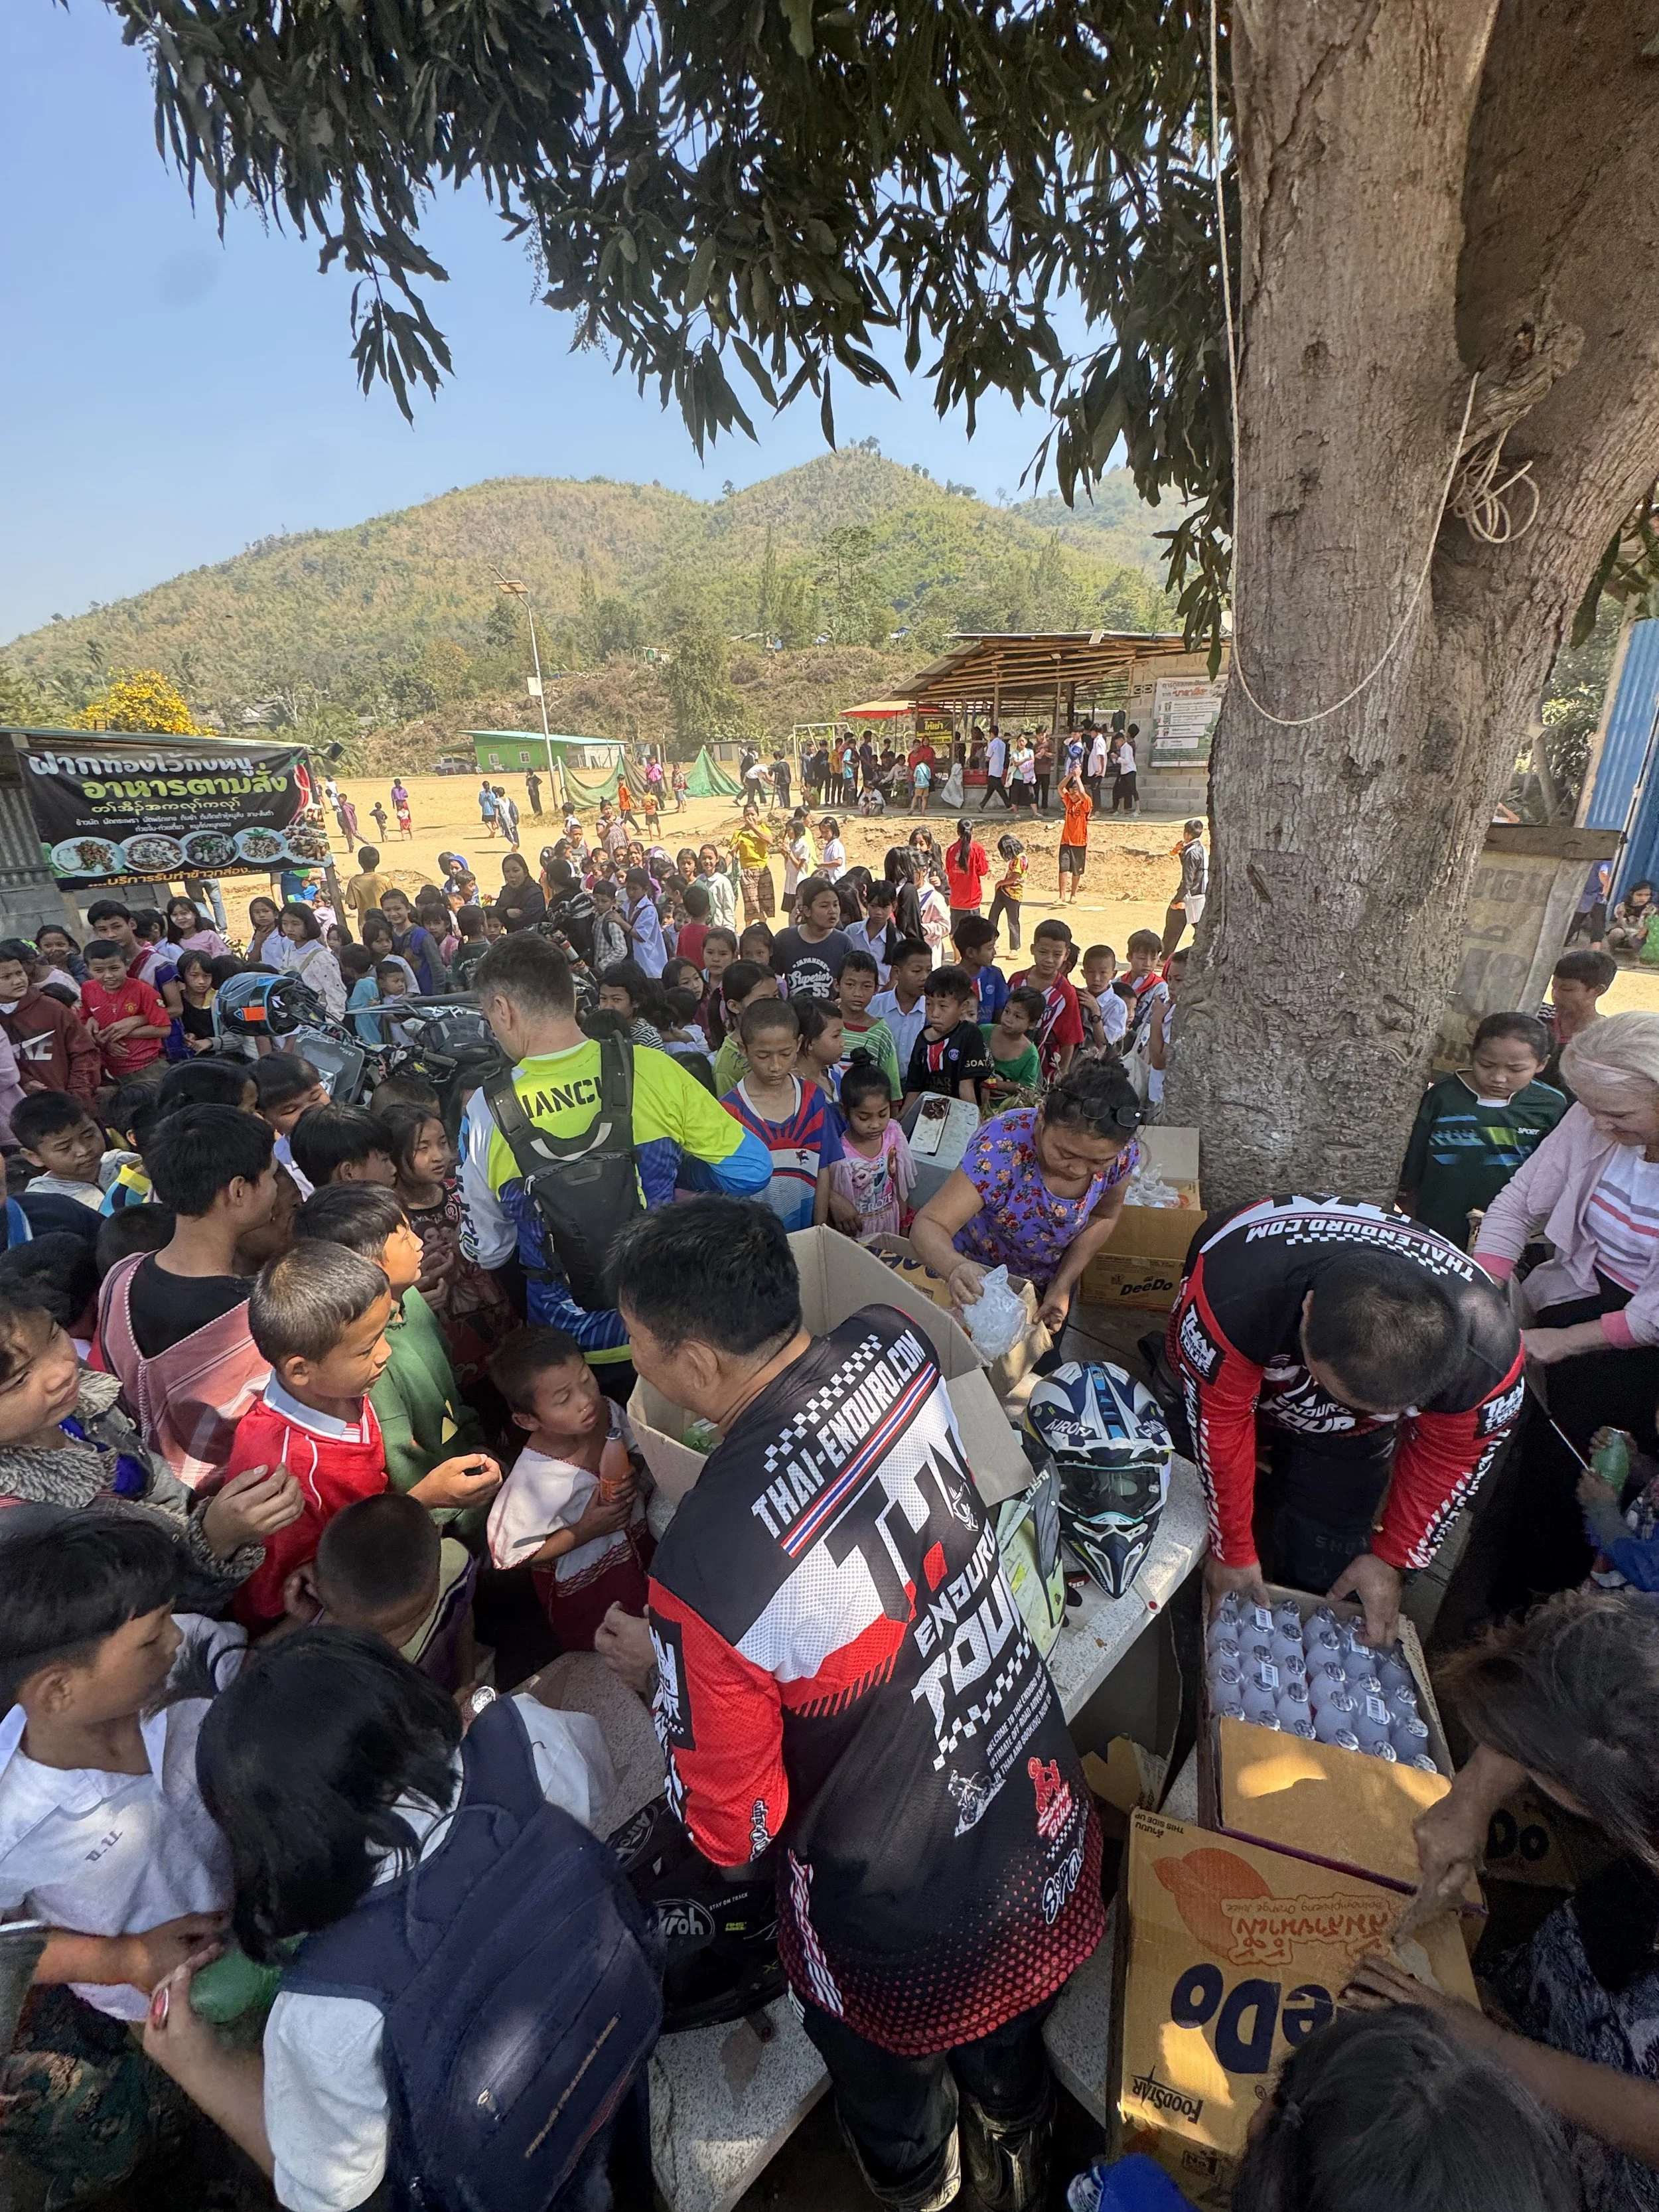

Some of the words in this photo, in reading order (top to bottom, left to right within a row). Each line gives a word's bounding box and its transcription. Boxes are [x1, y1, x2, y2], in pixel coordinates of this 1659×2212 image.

[29, 750, 254, 776] ฝากท้องไว้กับหนู
[82, 763, 287, 799] อาหารตามสั่ง
[787, 970, 833, 990] Superior
[812, 983, 830, 998] 55
[859, 1192, 893, 1214] FROZE
[1245, 1218, 1475, 1282] THAI-ENDURO.COM
[1120, 1278, 1173, 1296] DeeDo
[1275, 1394, 1354, 1418] ENDURO
[751, 1329, 926, 1539] THAI-ENDURO.COM
[913, 1517, 995, 1658] ENDURO
[985, 1722, 1010, 1757] WELCOME
[1007, 1713, 1015, 1726] TO
[1013, 1700, 1023, 1717] THAI
[1021, 1676, 1038, 1704] ENDURO
[989, 1735, 1013, 1769] ULTIMATE
[1011, 1710, 1032, 1741] OFF-ROAD
[1000, 1742, 1023, 1775] THAILAND
[1021, 1714, 1042, 1745] BOOKING
[1048, 1798, 1072, 1839] Bike
[1135, 1813, 1146, 1822] UP
[1135, 1821, 1164, 1838] ด้านบน
[1147, 1817, 1165, 1828] SIDE
[1166, 1824, 1184, 1834] THIS
[709, 1901, 722, 1911] STAY
[732, 1891, 749, 1902] TRACK
[1256, 1901, 1296, 1913] Orange
[1234, 1912, 1388, 1958] ส้มสายน้ำผึ้ง
